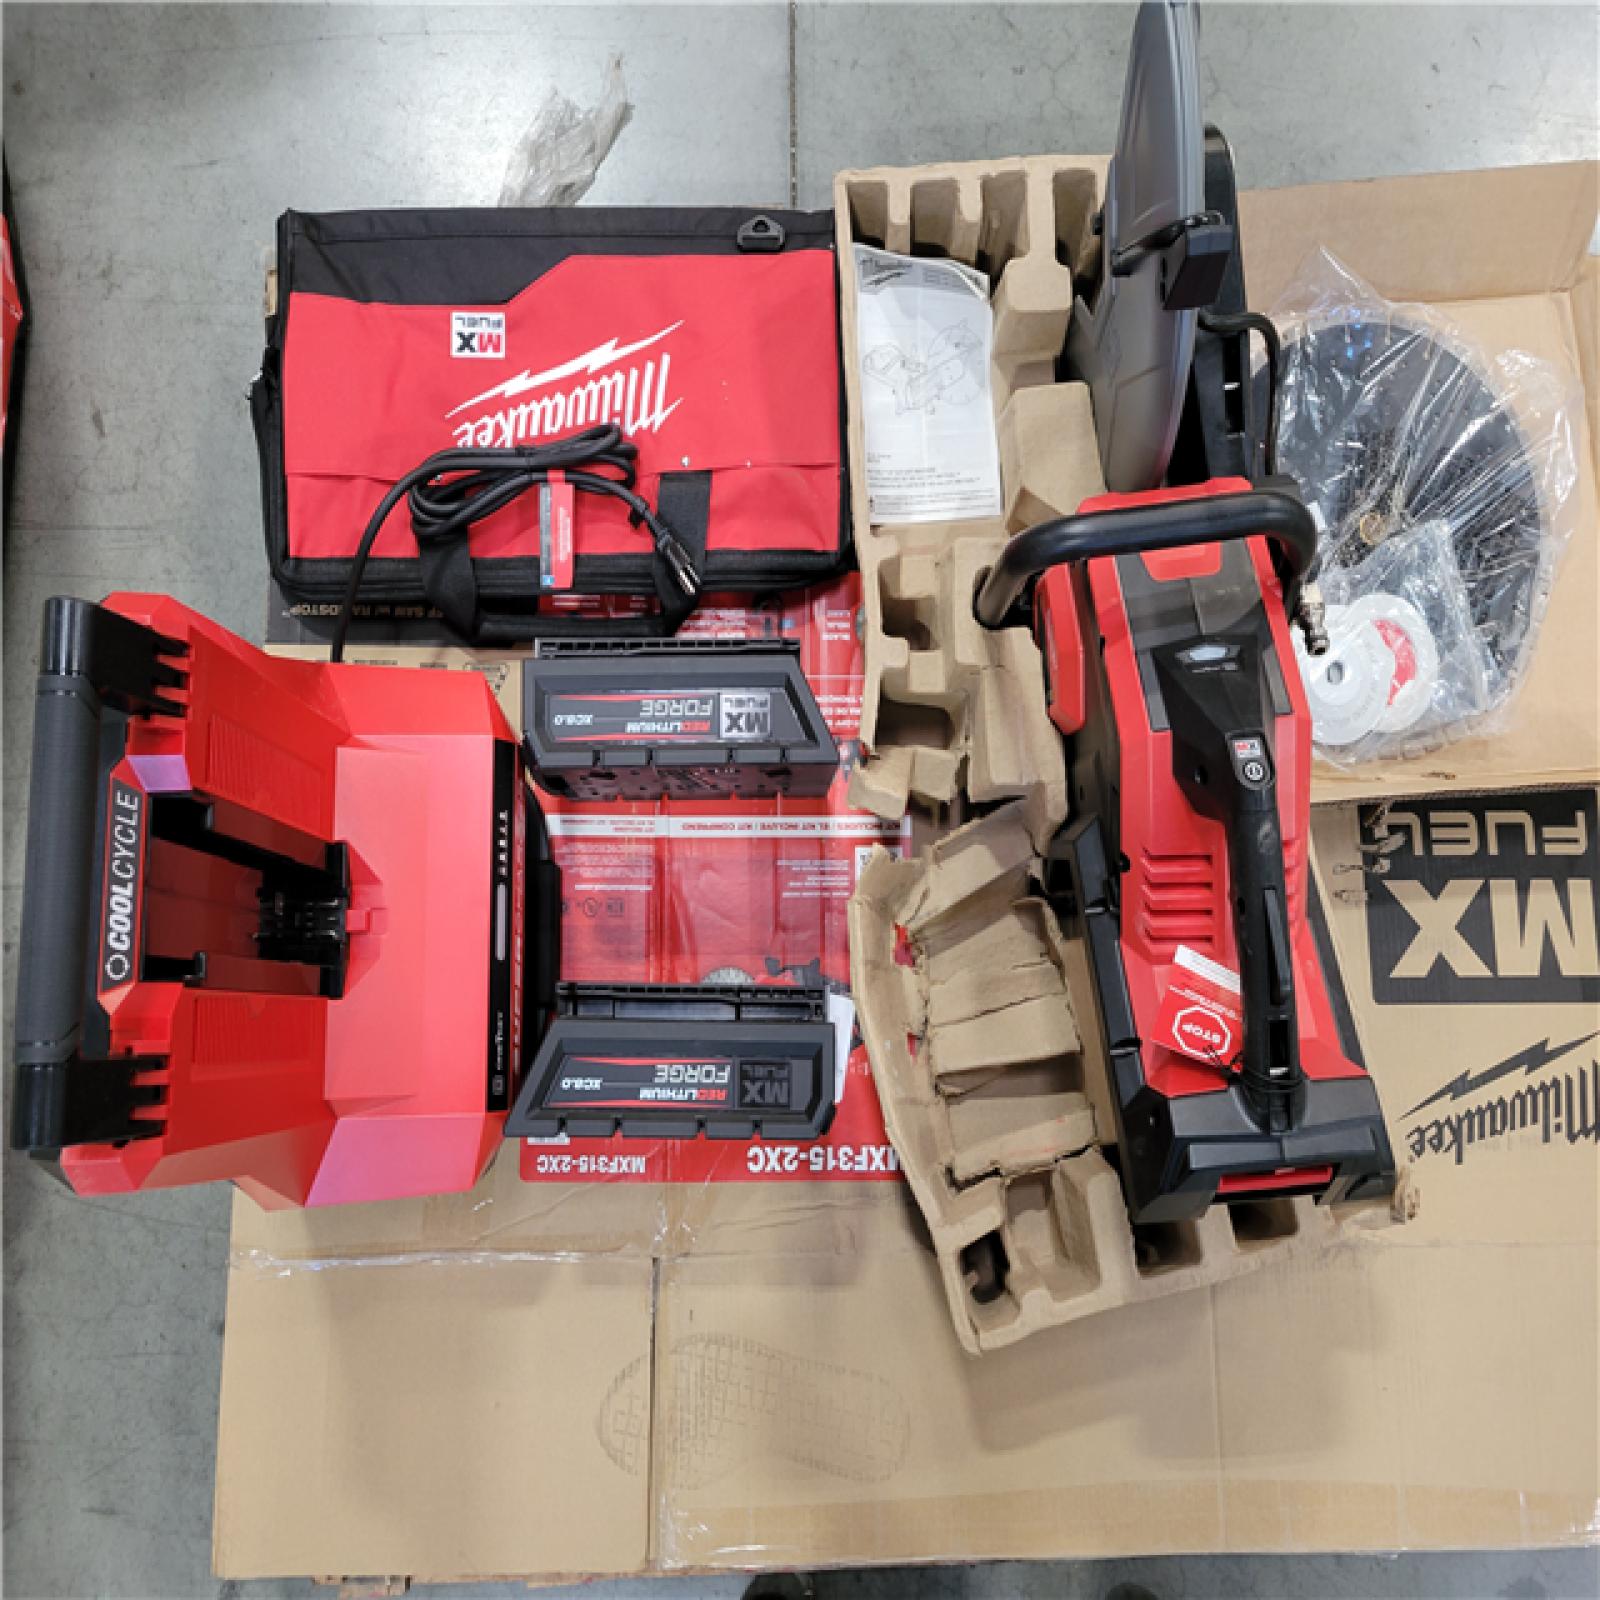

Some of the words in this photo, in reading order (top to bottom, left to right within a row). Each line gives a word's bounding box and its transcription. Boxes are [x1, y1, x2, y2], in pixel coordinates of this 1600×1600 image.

[456, 332, 501, 353] MX
[451, 352, 684, 448] Milwaukee
[640, 699, 713, 716] FORGE
[726, 712, 768, 733] MX
[1383, 809, 1588, 856] FUEL
[106, 789, 138, 951] COOLCYCLE
[1382, 878, 1599, 978] MX
[1181, 1023, 1222, 1045] STOP
[561, 1078, 602, 1090] XC8.0
[652, 1064, 731, 1083] FORGE
[639, 1087, 727, 1101] REDLITHIUM
[742, 1080, 788, 1104] MX
[536, 1154, 646, 1173] MXF315-2XC
